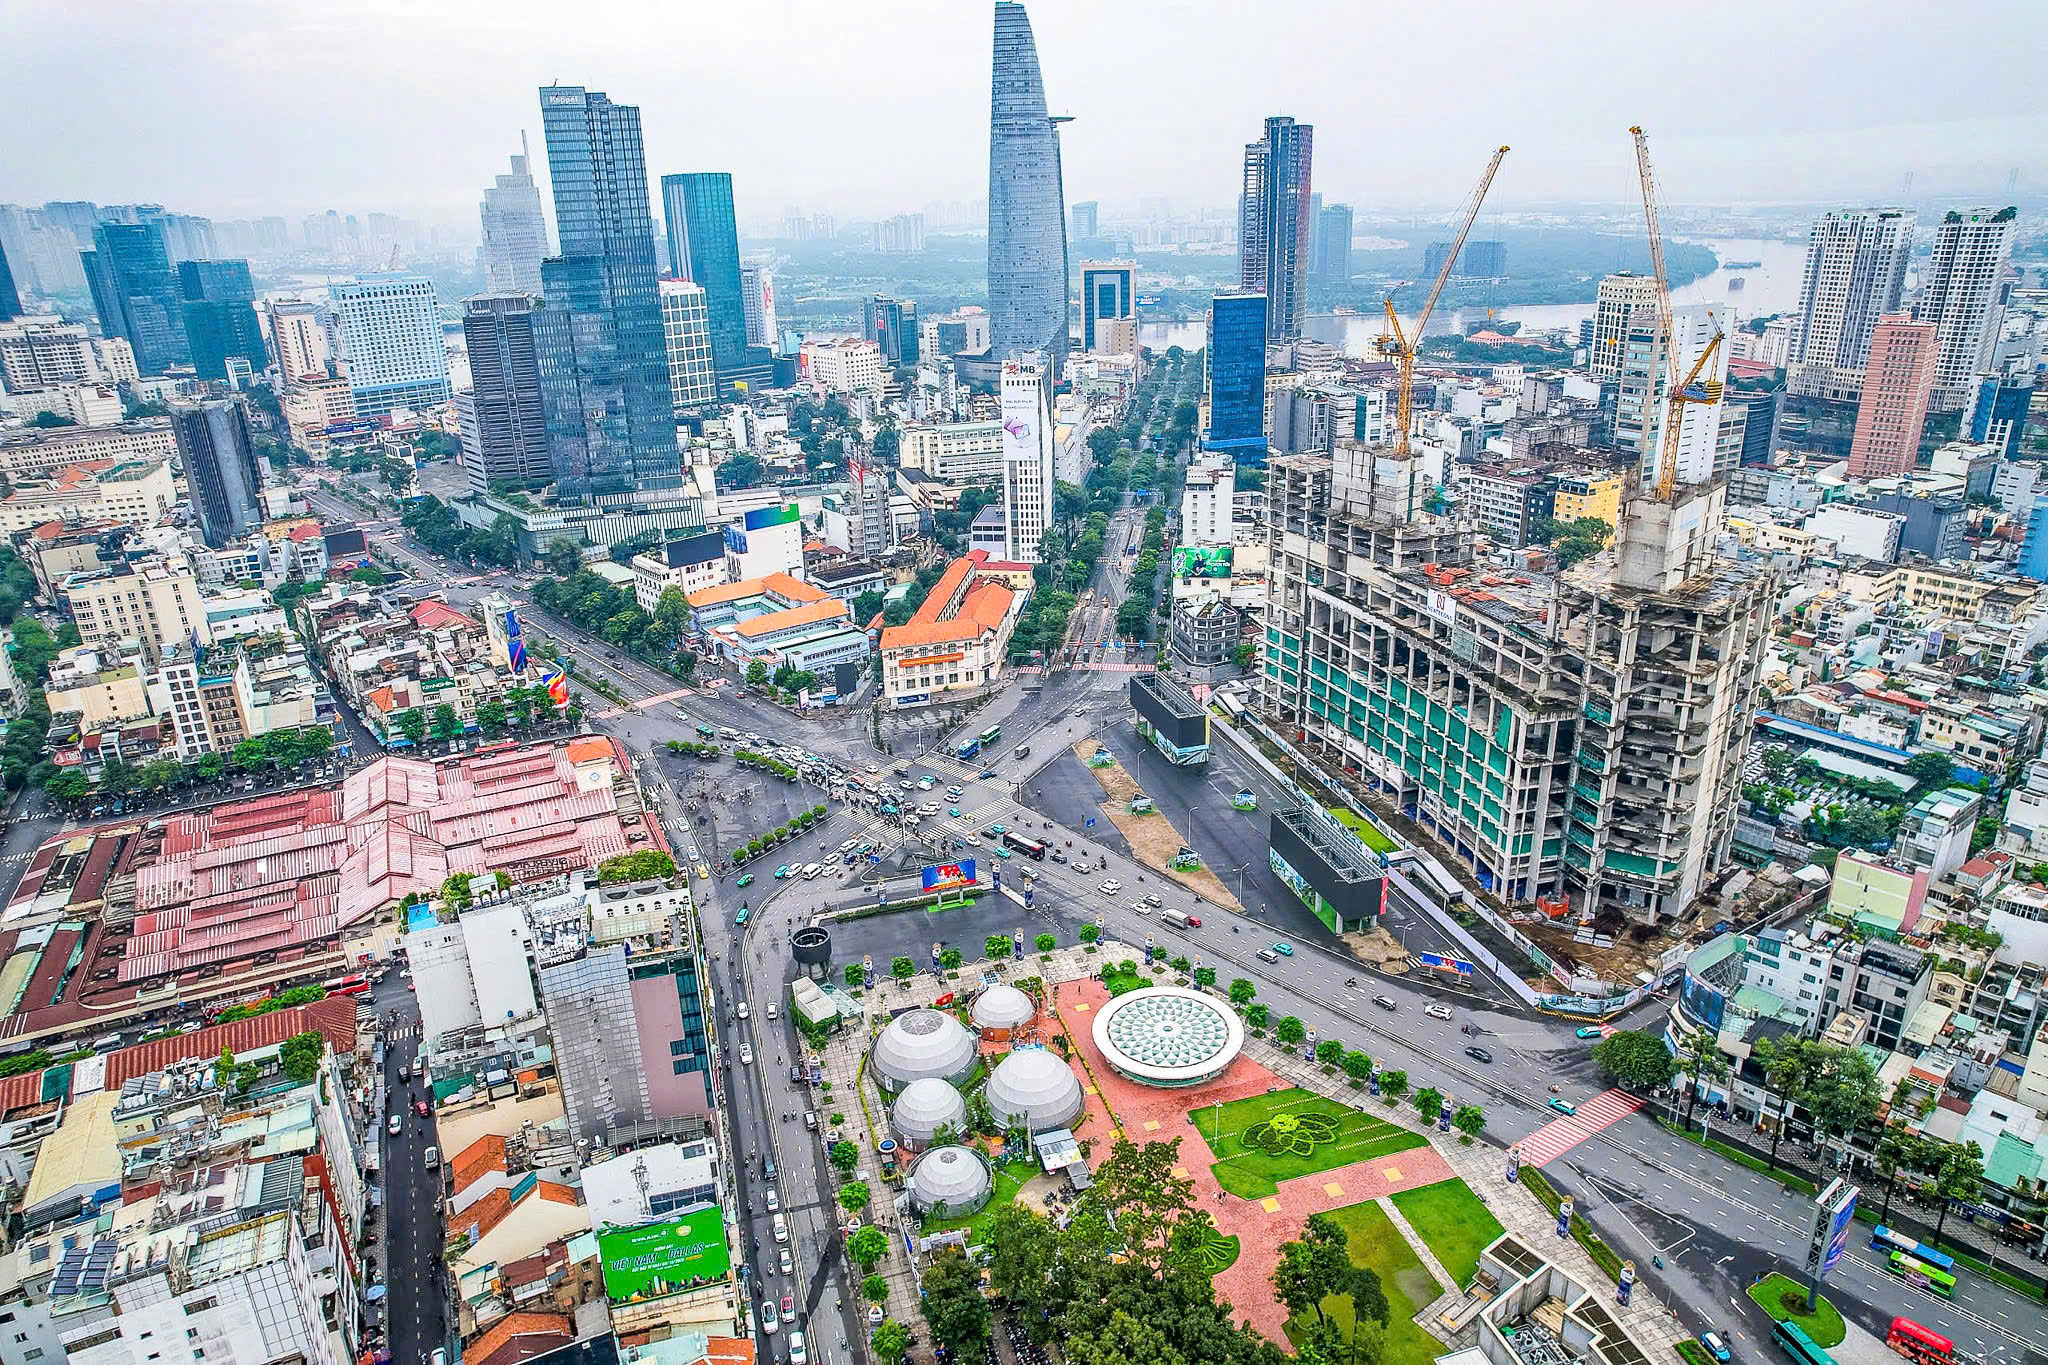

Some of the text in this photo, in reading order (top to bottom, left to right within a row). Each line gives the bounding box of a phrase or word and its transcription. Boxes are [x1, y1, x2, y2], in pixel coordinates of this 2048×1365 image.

[1020, 365, 1035, 374] MB
[633, 1252, 657, 1266] NAM
[668, 1242, 705, 1260] DALLAS
